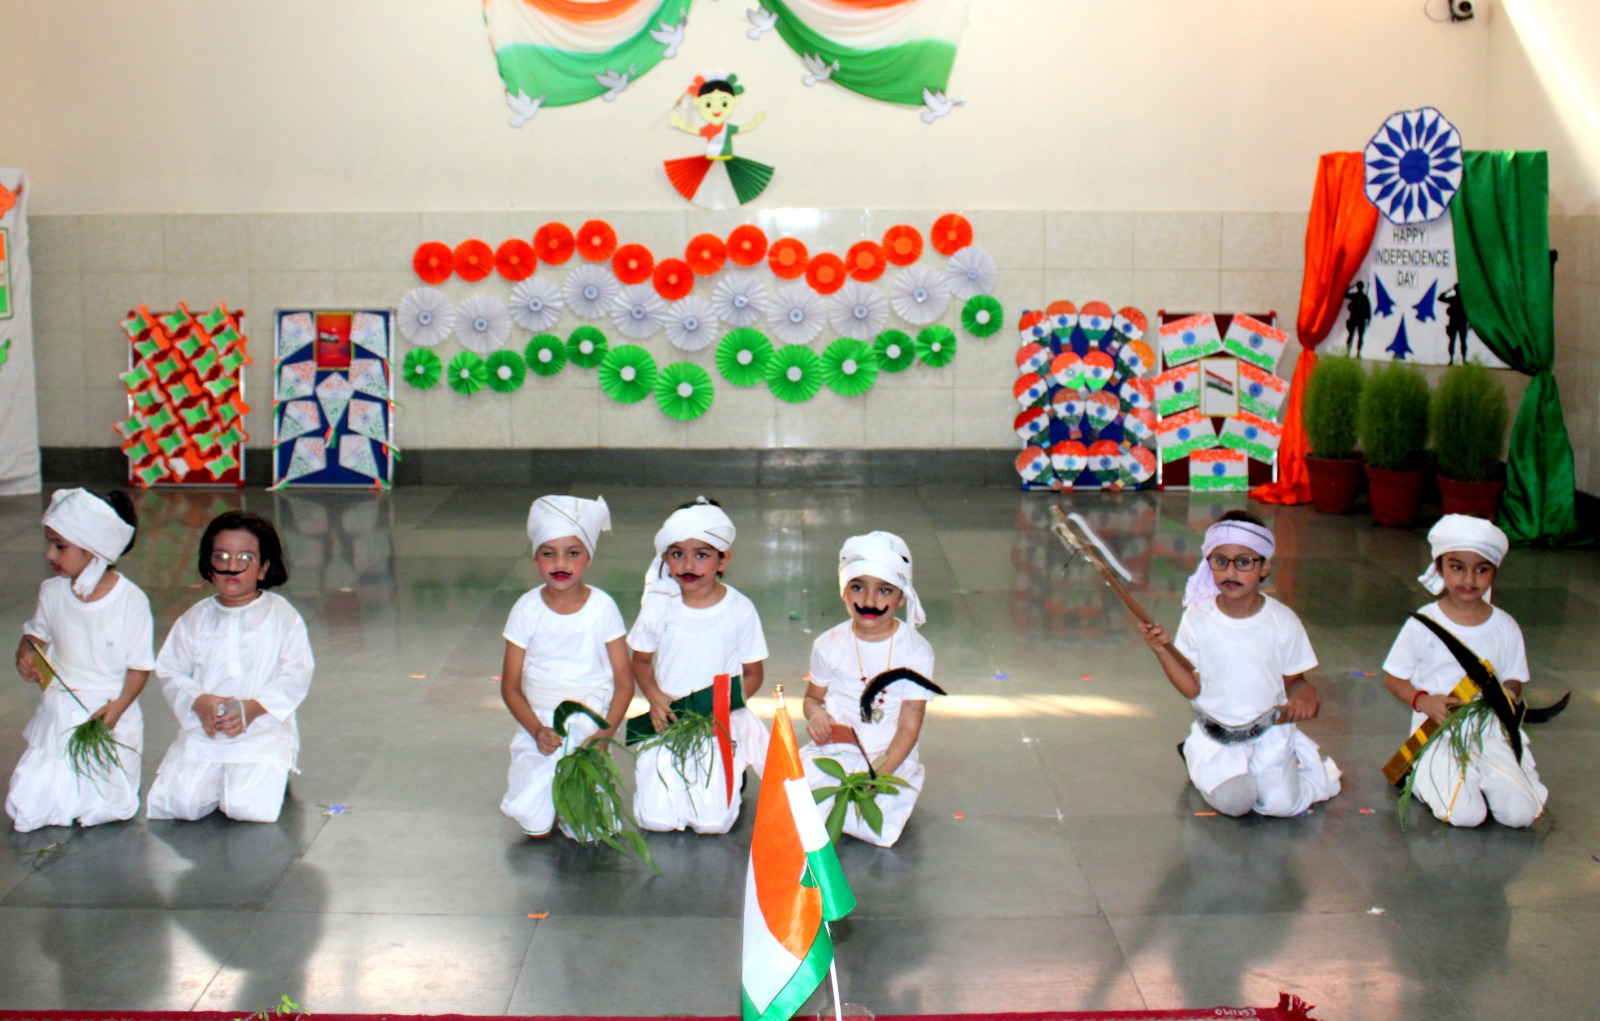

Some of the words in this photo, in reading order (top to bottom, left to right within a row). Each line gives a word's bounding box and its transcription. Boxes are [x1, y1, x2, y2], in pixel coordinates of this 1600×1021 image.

[1393, 227, 1426, 242] HAPPY
[1376, 248, 1450, 266] INDEPENDENCE
[1397, 270, 1416, 286] DAY
[1214, 1008, 1257, 1016] ESKIMO
